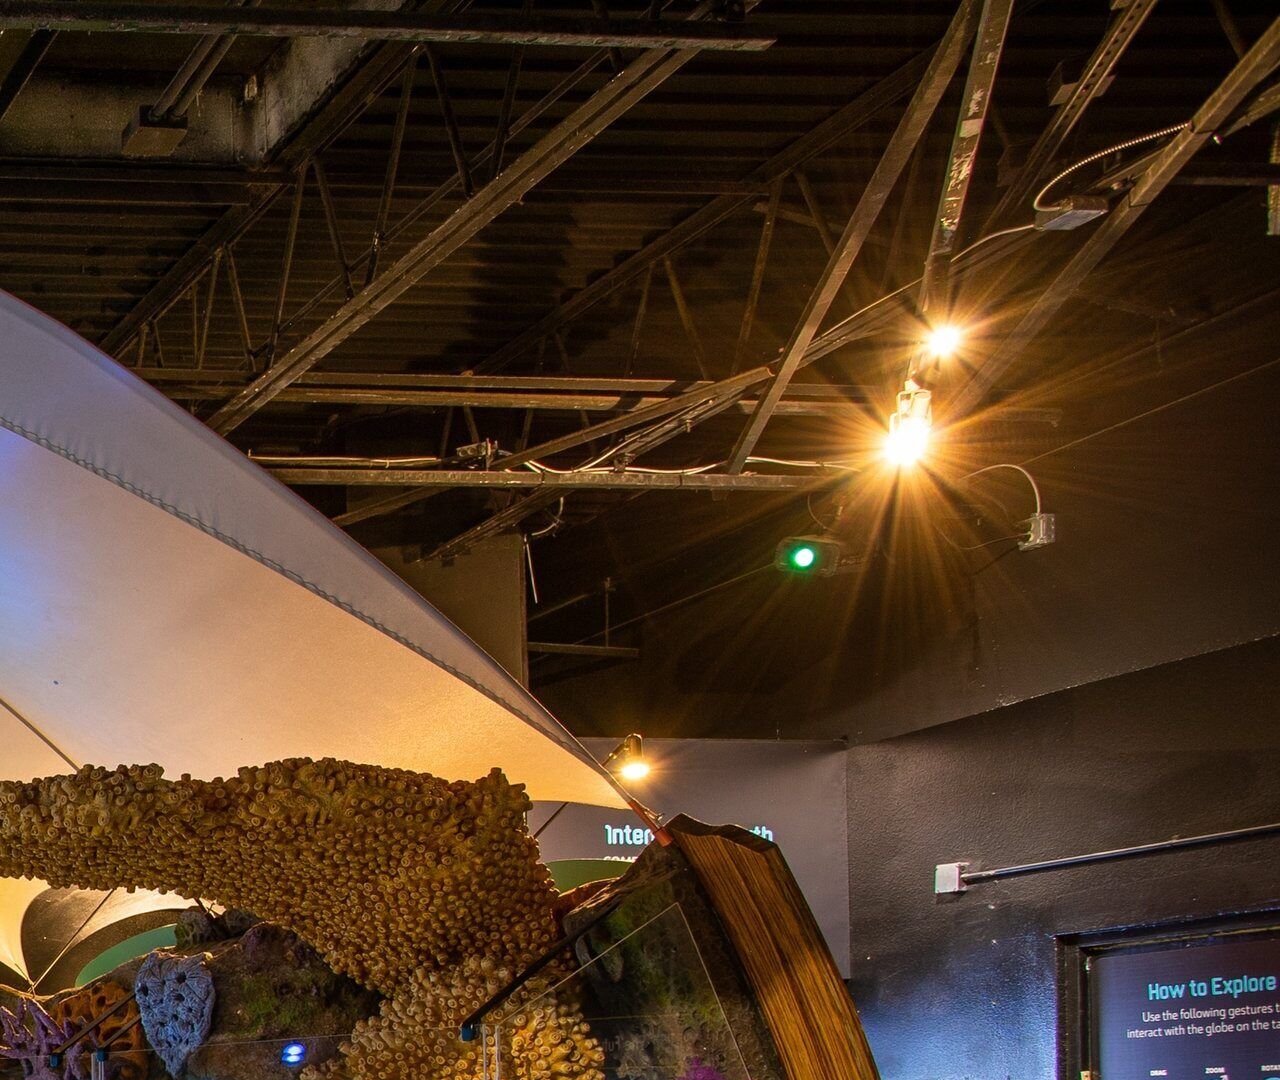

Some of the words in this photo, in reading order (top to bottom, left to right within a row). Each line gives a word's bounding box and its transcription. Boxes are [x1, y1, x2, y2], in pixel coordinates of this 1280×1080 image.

[1148, 983, 1185, 1000] How
[1189, 980, 1207, 997] to
[1211, 975, 1277, 998] Explore
[1142, 1011, 1161, 1023] Use
[1162, 1010, 1178, 1020] the
[1180, 1007, 1226, 1020] following
[1228, 1004, 1273, 1019] gestures
[1127, 1027, 1162, 1039] interact
[1163, 1025, 1185, 1037] with
[1187, 1024, 1204, 1035] the
[1205, 1022, 1234, 1037] globe
[1236, 1022, 1250, 1031] on
[1252, 1020, 1269, 1030] the
